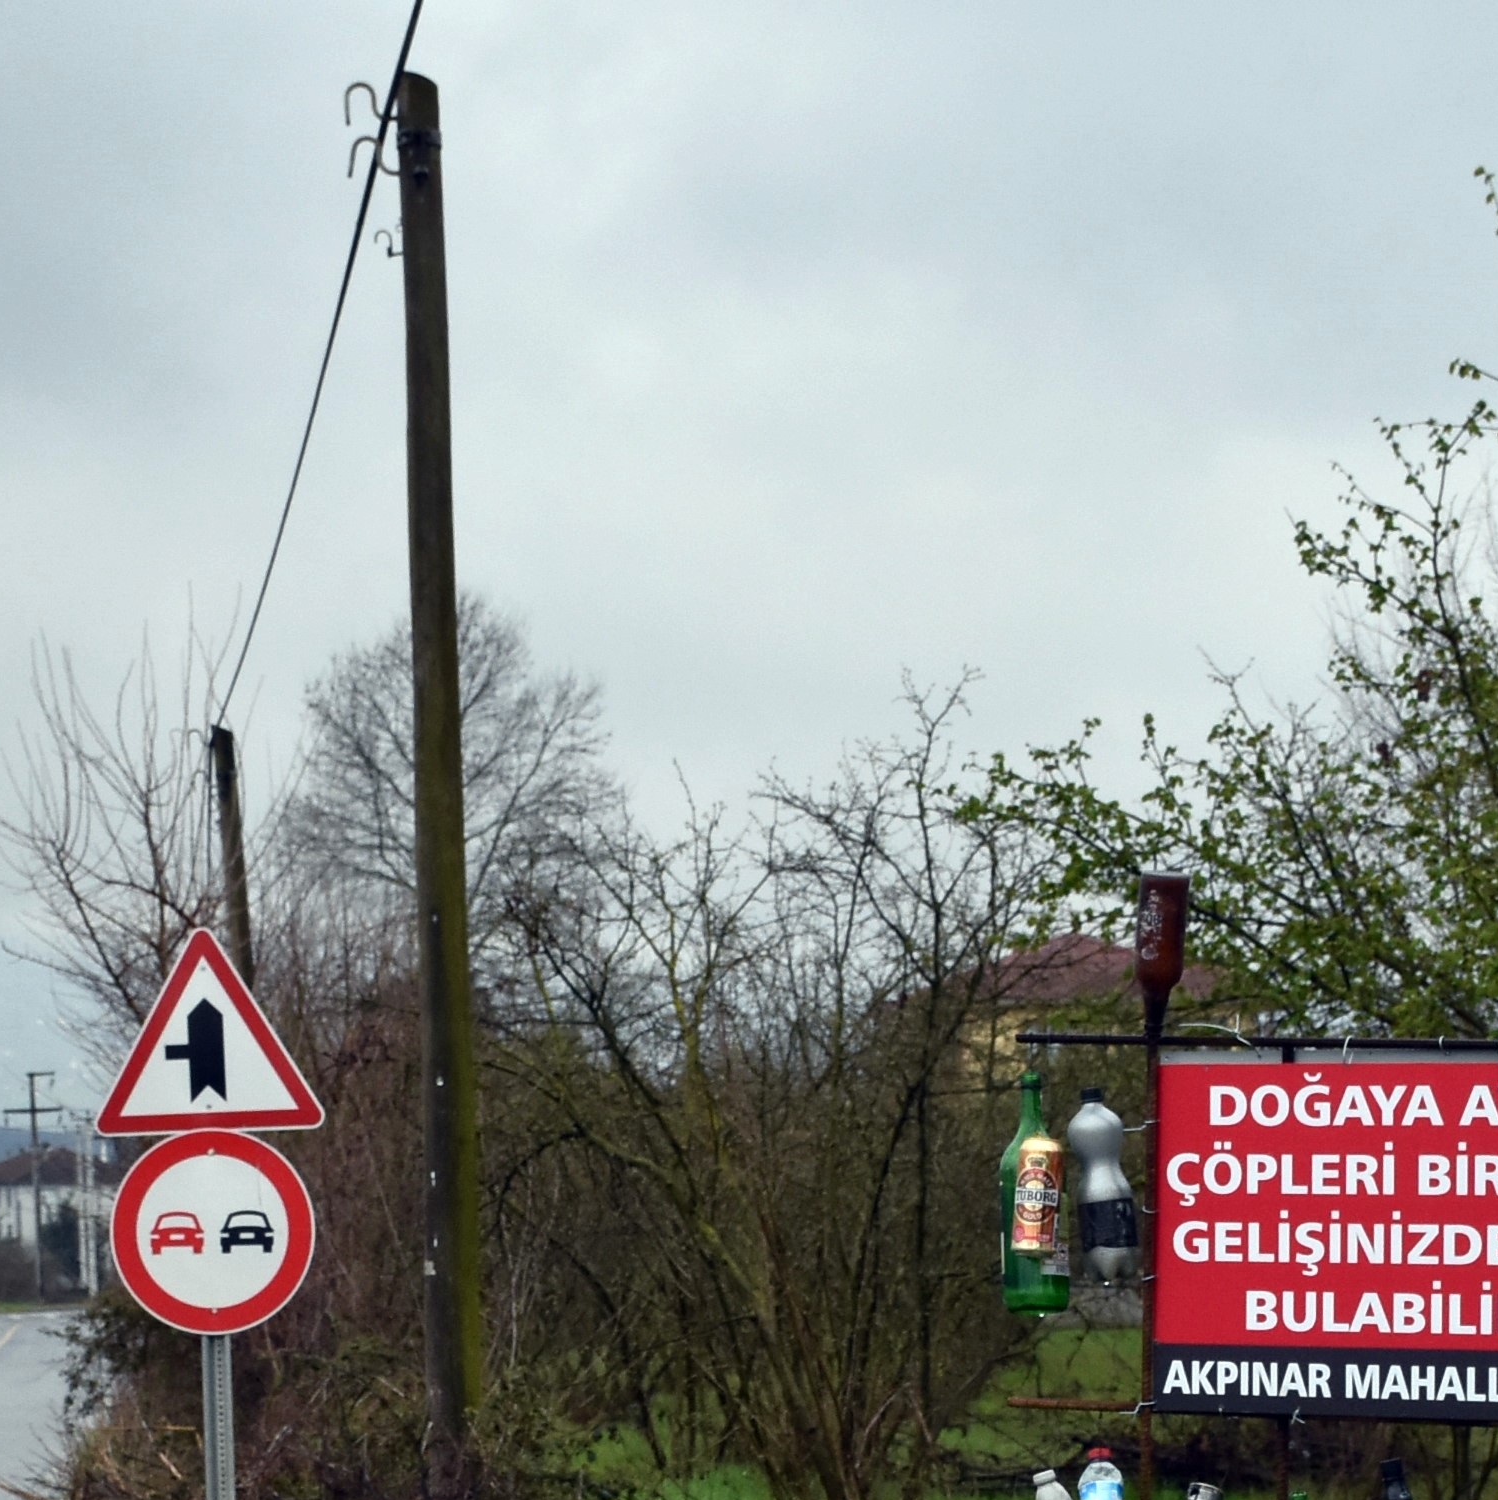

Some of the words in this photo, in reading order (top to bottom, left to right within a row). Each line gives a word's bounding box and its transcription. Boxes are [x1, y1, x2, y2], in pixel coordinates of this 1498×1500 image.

[1210, 1073, 1443, 1126] DOĞAYA
[1167, 1142, 1394, 1206] ÇÖPLERİ
[1016, 1190, 1057, 1204] TUBORG
[1163, 1360, 1331, 1397] AKPINAR
